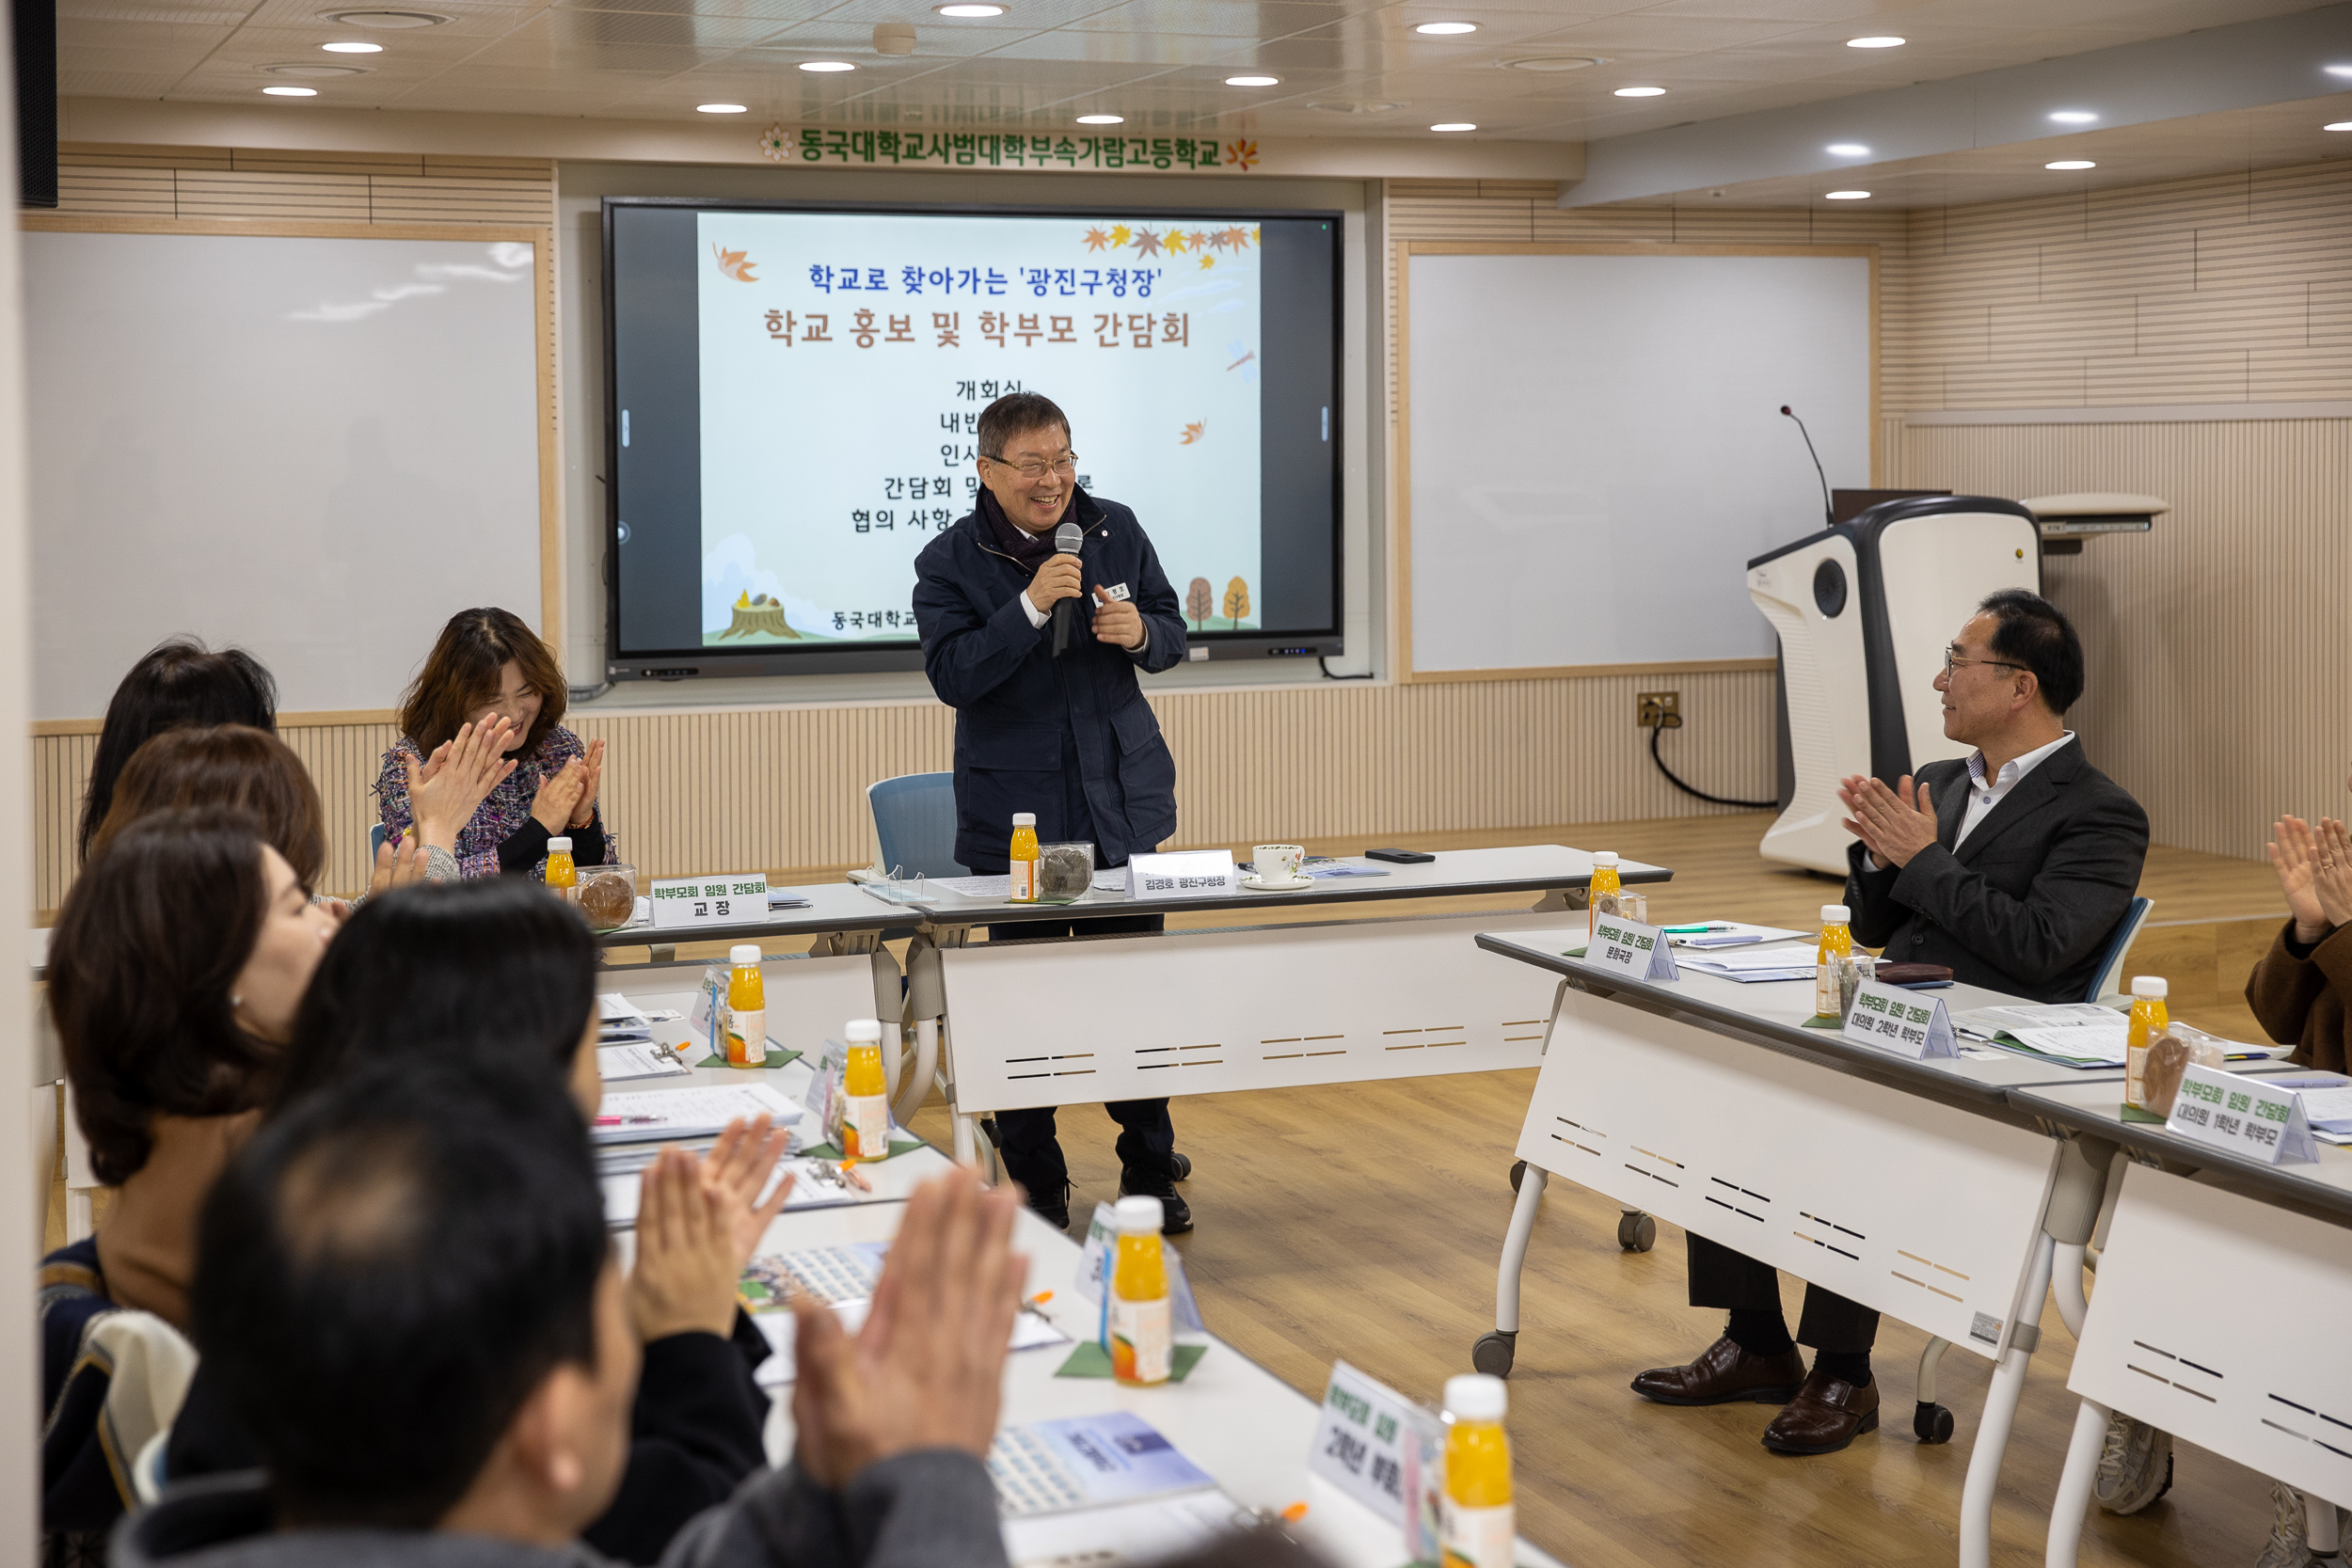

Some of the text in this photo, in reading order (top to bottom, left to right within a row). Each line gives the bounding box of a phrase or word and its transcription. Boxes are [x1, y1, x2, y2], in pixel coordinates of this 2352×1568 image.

[798, 129, 1221, 169] 동국대학교사범대학부속가람고등학교
[809, 264, 1162, 297] 학교로 찾아가는 '광진구청장'
[764, 309, 1190, 348] 학교 홍보 및 학부모 간담회
[884, 476, 951, 499] 간담회
[851, 509, 894, 532] 협의
[654, 881, 766, 899] 학부모회 임원 간담회
[1179, 876, 1226, 888] 광진구청장
[1597, 924, 1655, 951] 학부모회 임원 간담회
[1858, 992, 1931, 1025] 학부모회 임원 간담회
[1851, 1012, 1926, 1045] 대의원 2학년 학부모
[2181, 1078, 2291, 1124] 학부모회 임원 간담회
[2176, 1102, 2279, 1147] 대의원 1학년 학부모
